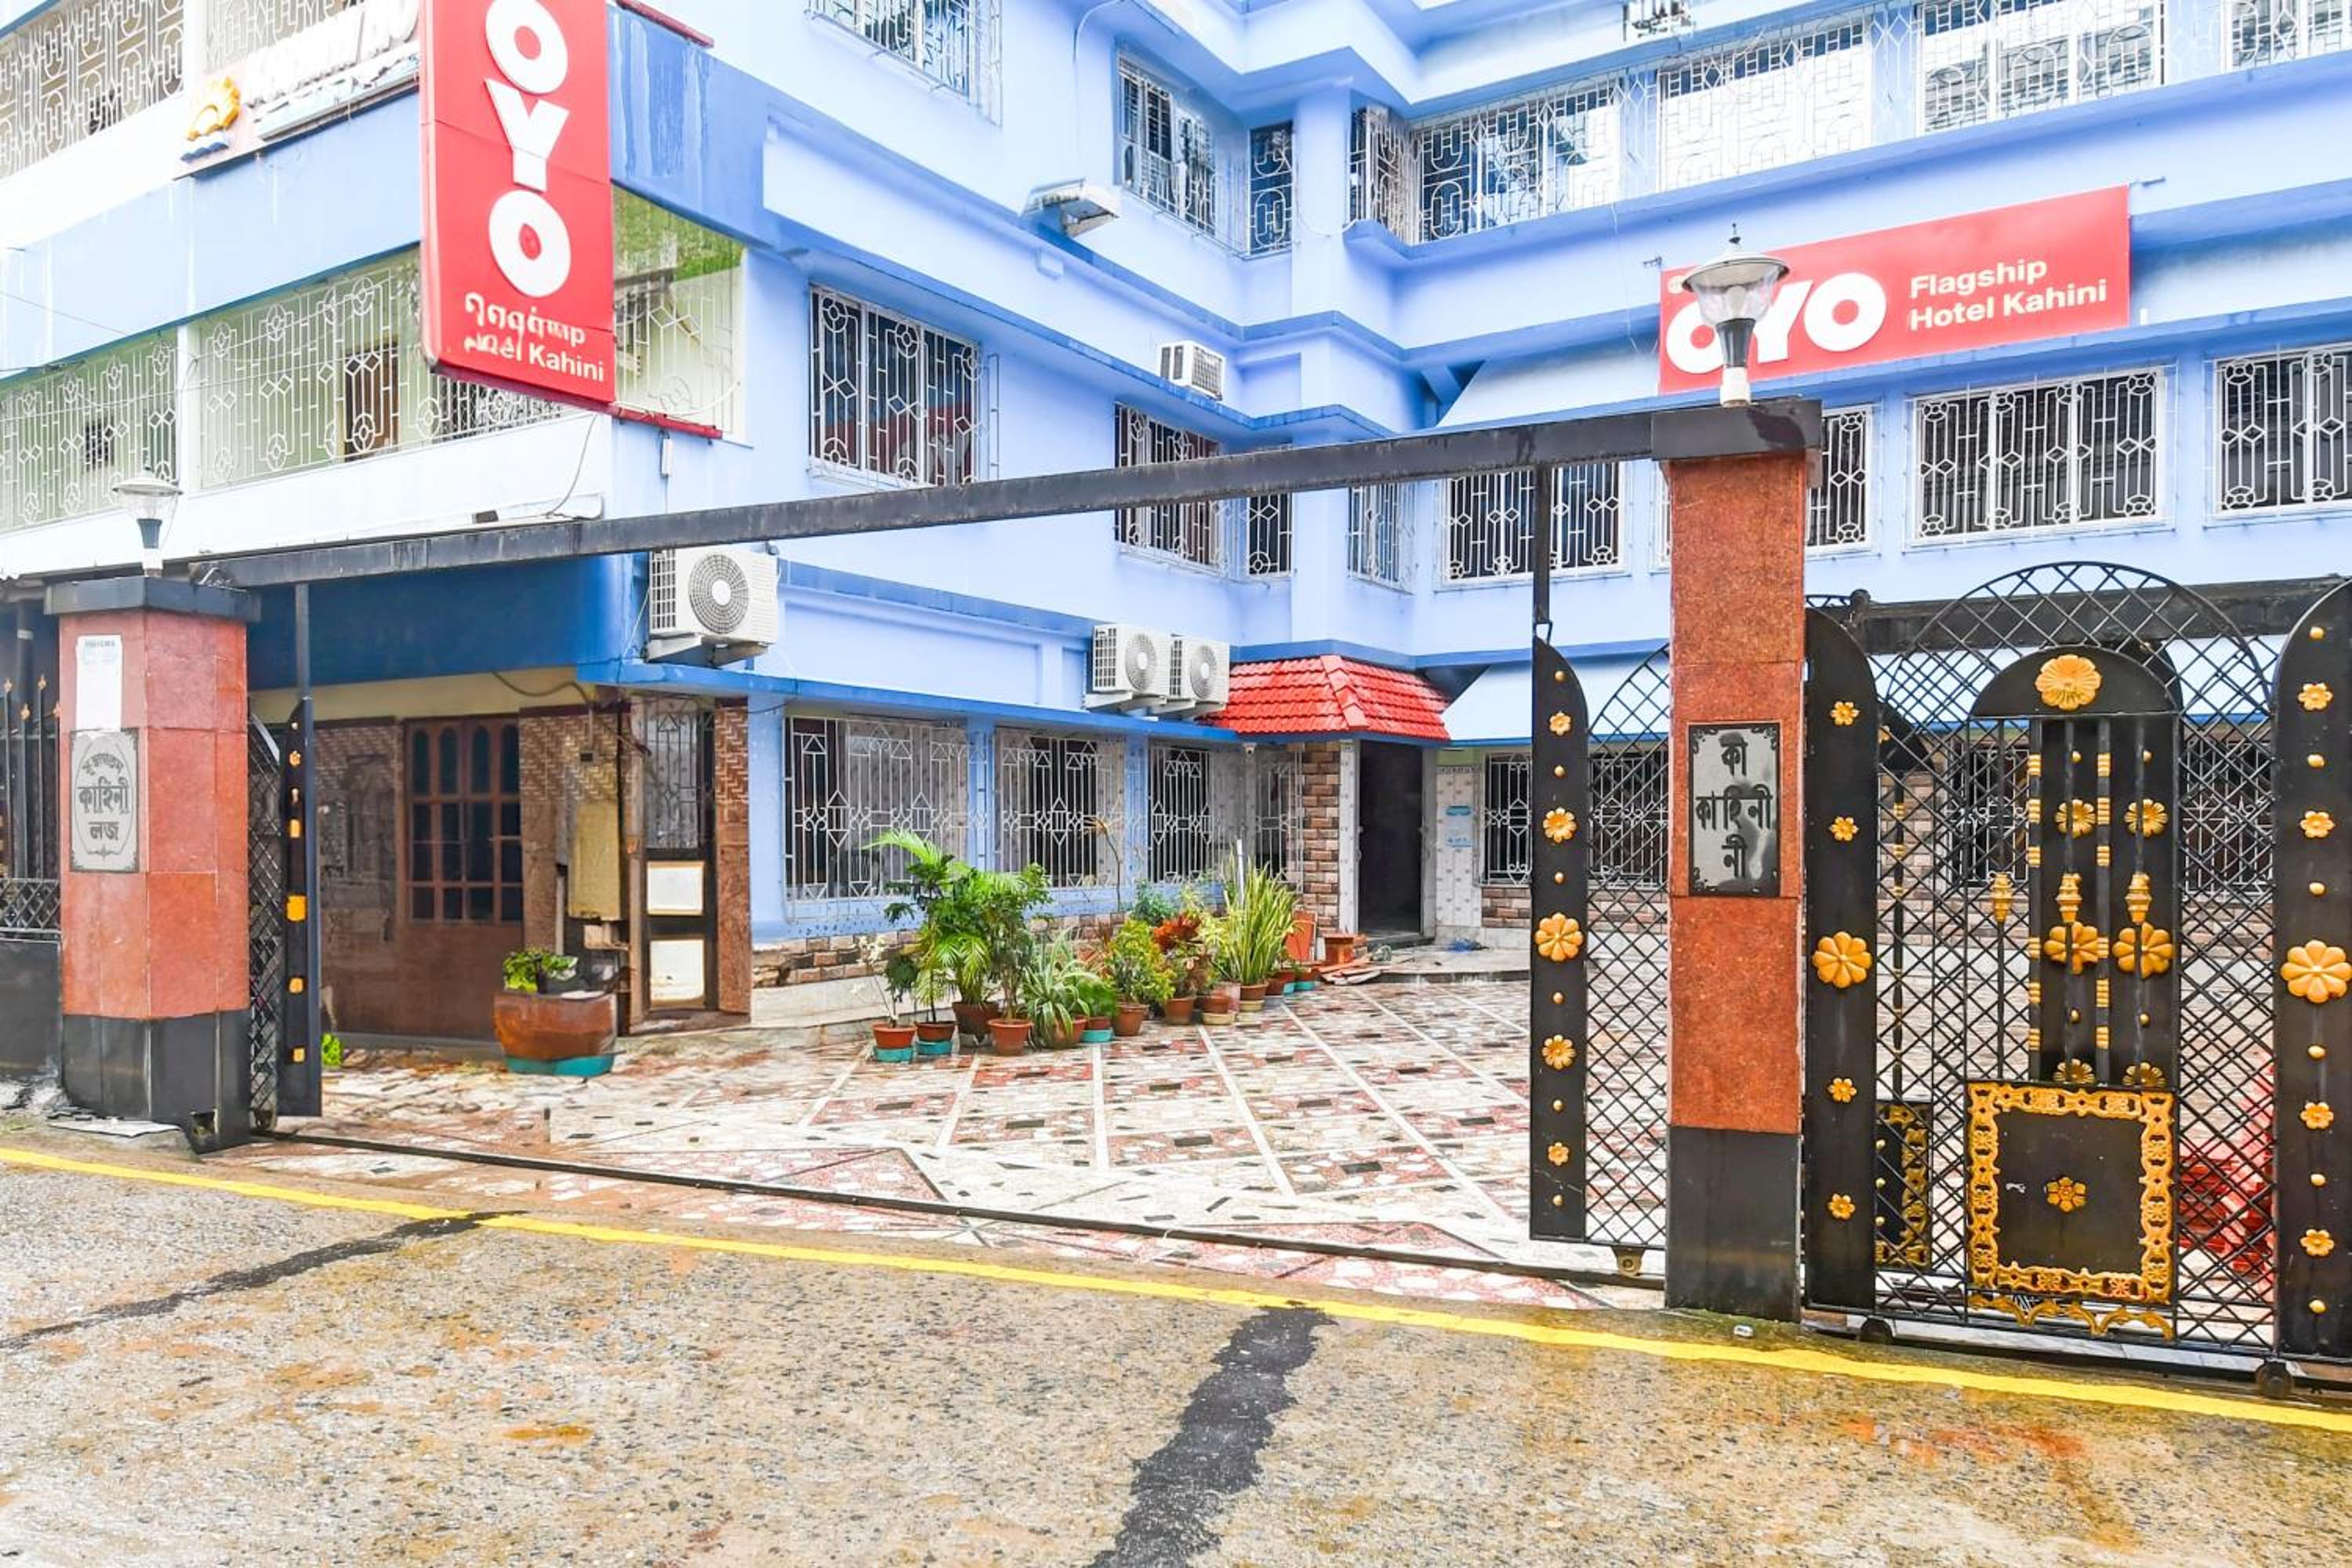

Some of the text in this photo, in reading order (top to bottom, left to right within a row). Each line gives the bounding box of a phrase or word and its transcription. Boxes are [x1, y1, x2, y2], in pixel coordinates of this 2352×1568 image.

[484, 0, 571, 298] OYO
[1909, 259, 2047, 299] Flagship
[1908, 279, 2107, 332] Hotel Kahini
[528, 341, 604, 383] Kahini
[78, 776, 129, 815] কাহিনী
[88, 821, 120, 841] লজ
